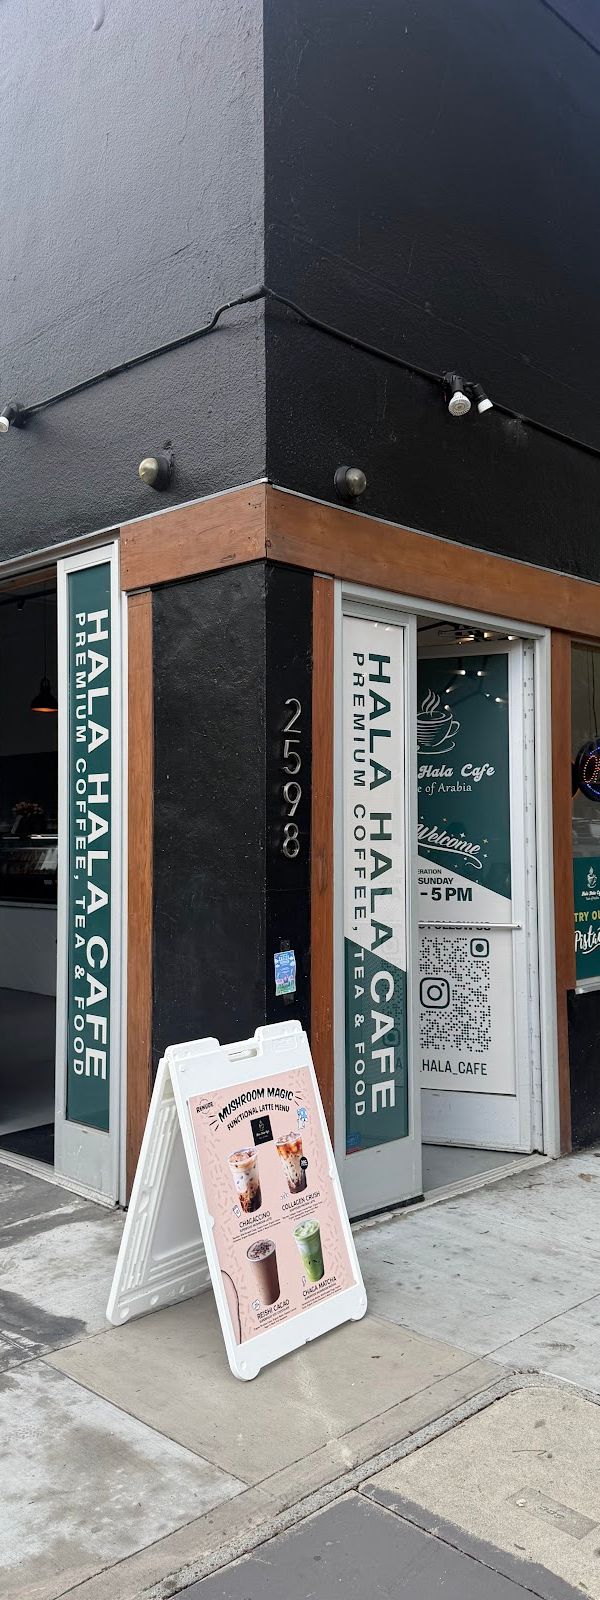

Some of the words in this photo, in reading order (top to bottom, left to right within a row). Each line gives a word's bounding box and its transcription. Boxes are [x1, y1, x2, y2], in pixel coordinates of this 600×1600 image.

[75, 612, 87, 742] PREMIUM
[87, 609, 109, 753] HALA
[352, 652, 366, 787] PREMIUM
[368, 653, 392, 791] HALA
[282, 698, 302, 858] 2598
[417, 764, 454, 779] Hala
[460, 763, 495, 782] Cafe
[425, 782, 436, 796] of
[438, 781, 472, 792] Arabia
[74, 758, 87, 880] COFFEE,
[87, 773, 109, 914] HALA
[417, 823, 481, 855] Welcome
[352, 803, 366, 931] COFFEE,
[369, 812, 393, 951] HALA
[417, 877, 454, 885] SUNDAY
[431, 887, 442, 901] 5
[445, 887, 473, 901] PM
[74, 896, 86, 949] TEA
[573, 911, 589, 922] TRY
[74, 964, 85, 980] &
[85, 935, 109, 1080] CAFE
[353, 948, 365, 999] TEA
[73, 996, 85, 1075] FOOD
[354, 1013, 365, 1028] &
[370, 970, 395, 1113] CAFE
[218, 1088, 265, 1122] MUSHROOM
[267, 1087, 294, 1101] MAGIC
[354, 1041, 366, 1116] FOOD
[227, 1108, 258, 1131] FUNCTIONAL
[259, 1103, 274, 1112] LATTE
[274, 1103, 290, 1112] MENU
